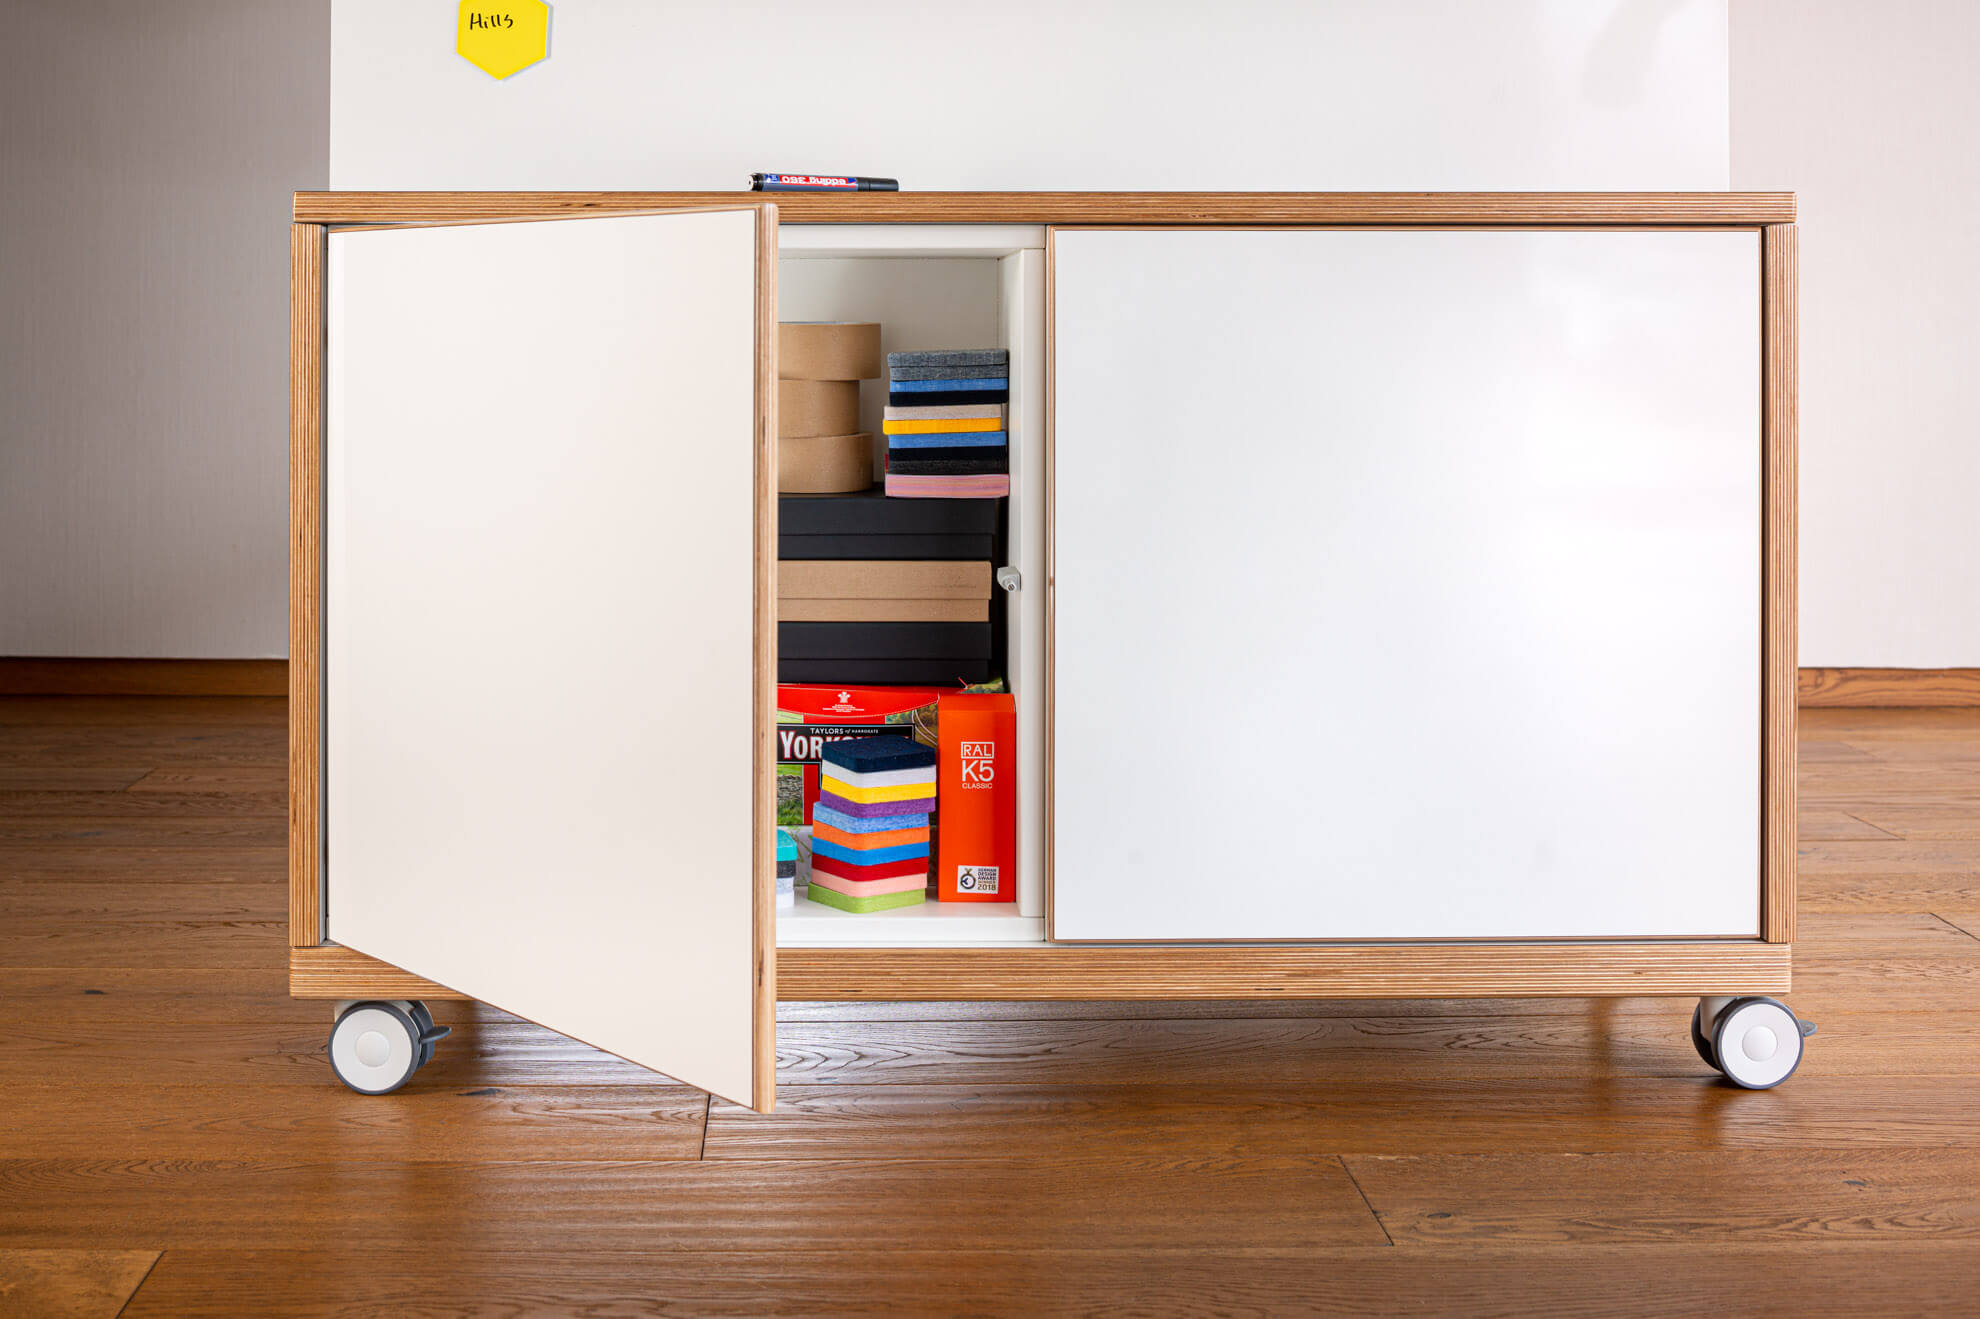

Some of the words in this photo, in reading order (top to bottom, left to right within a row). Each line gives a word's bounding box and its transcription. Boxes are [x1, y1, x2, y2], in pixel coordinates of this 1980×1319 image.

[470, 12, 513, 30] Hills
[781, 175, 807, 184] 360
[809, 176, 846, 185] edding
[964, 744, 992, 756] RAL
[962, 760, 994, 782] K5
